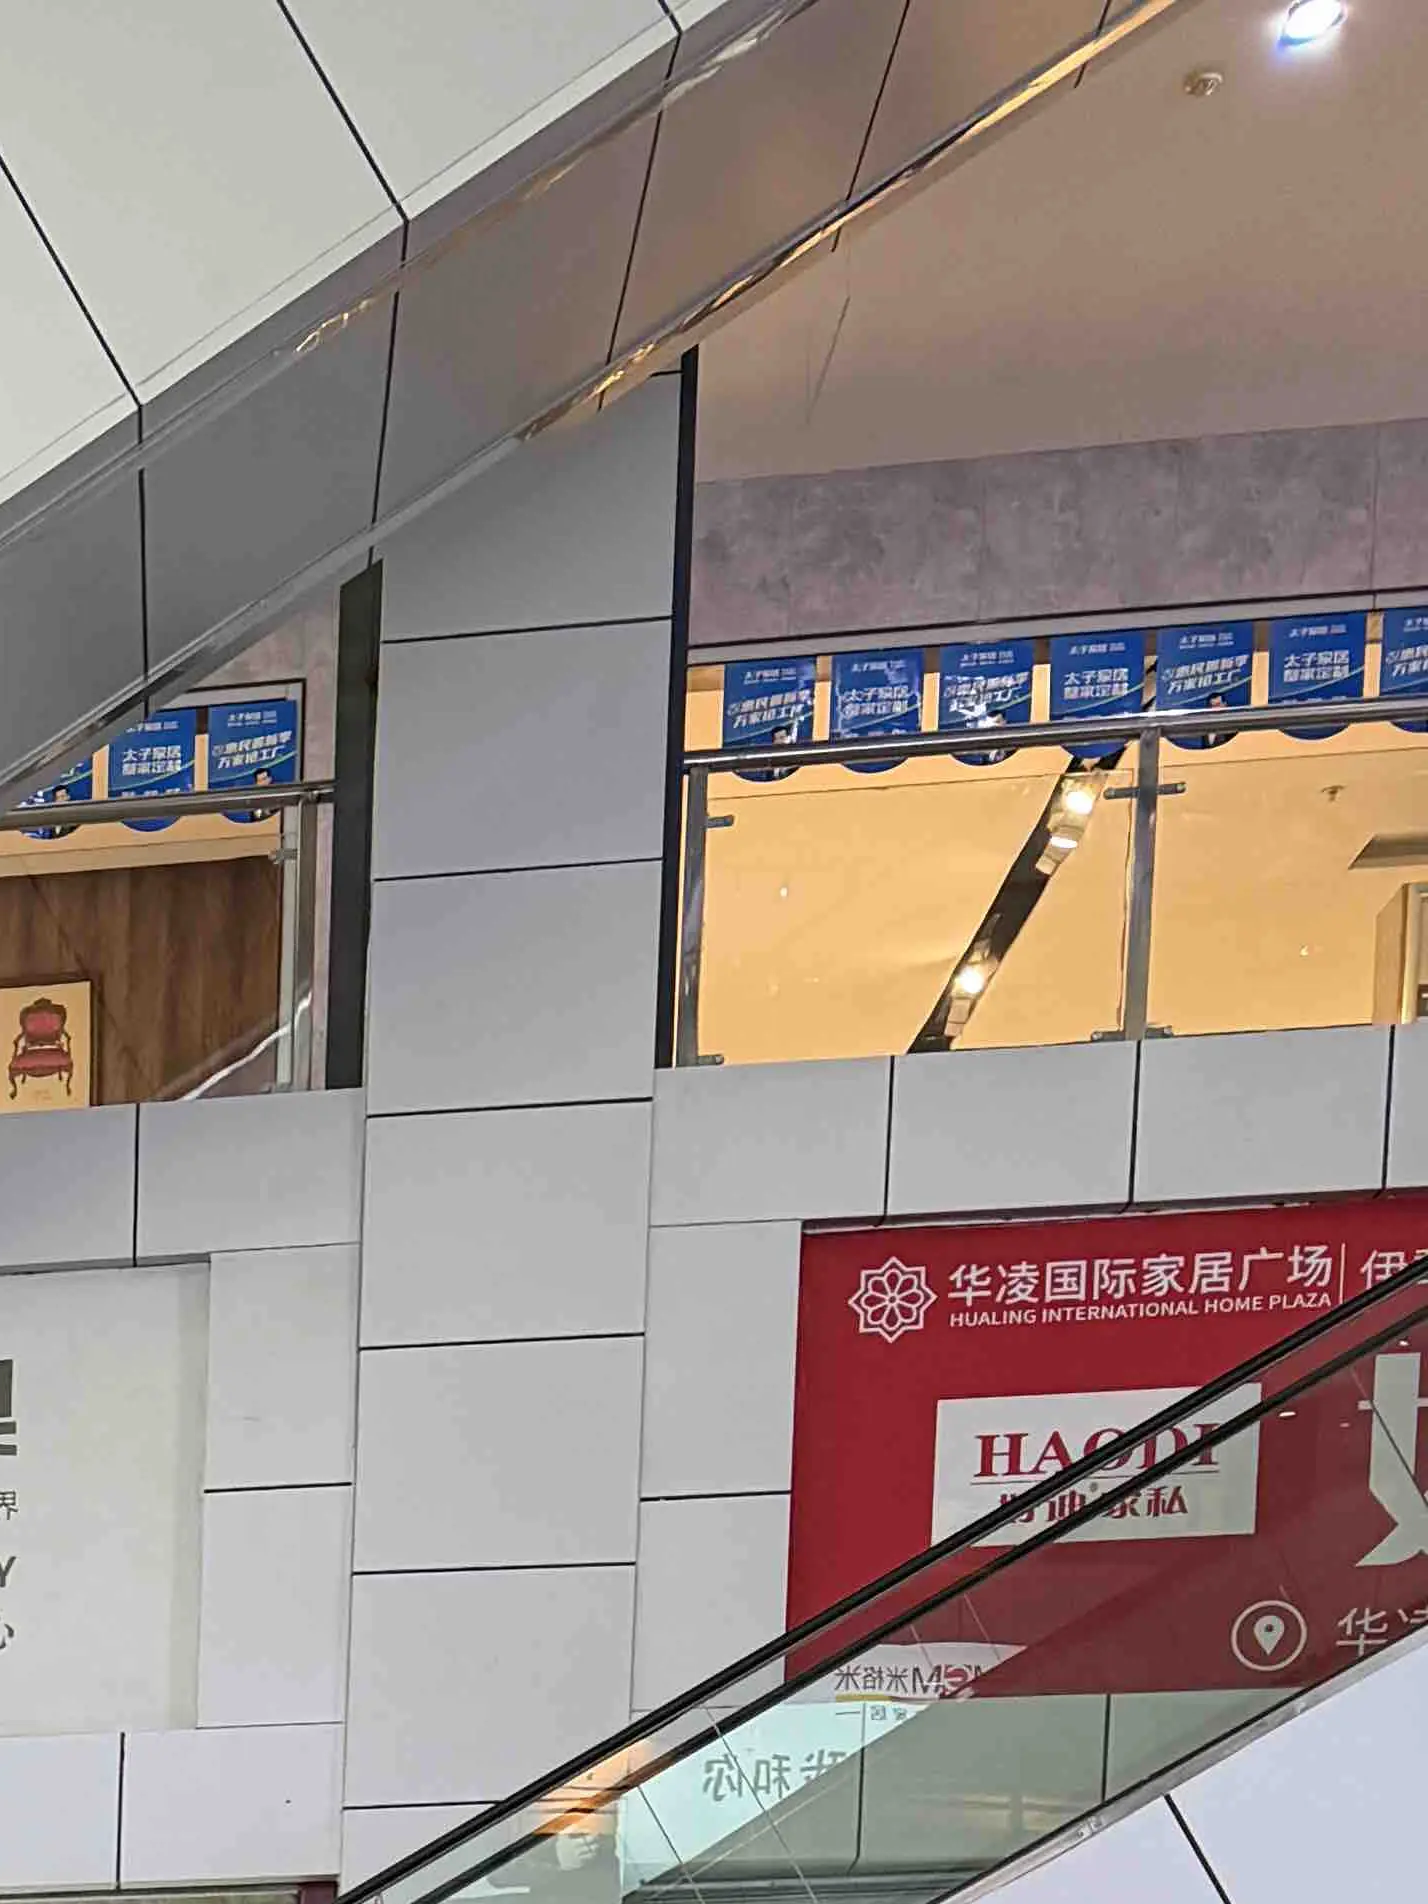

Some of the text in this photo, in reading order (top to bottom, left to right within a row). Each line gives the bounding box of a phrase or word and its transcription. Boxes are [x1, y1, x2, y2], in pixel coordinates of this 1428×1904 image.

[948, 1245, 1428, 1307] 华凌国际家居广场 伊
[950, 1292, 1332, 1328] HUALING INTERNATIONAL HOME PLAZA
